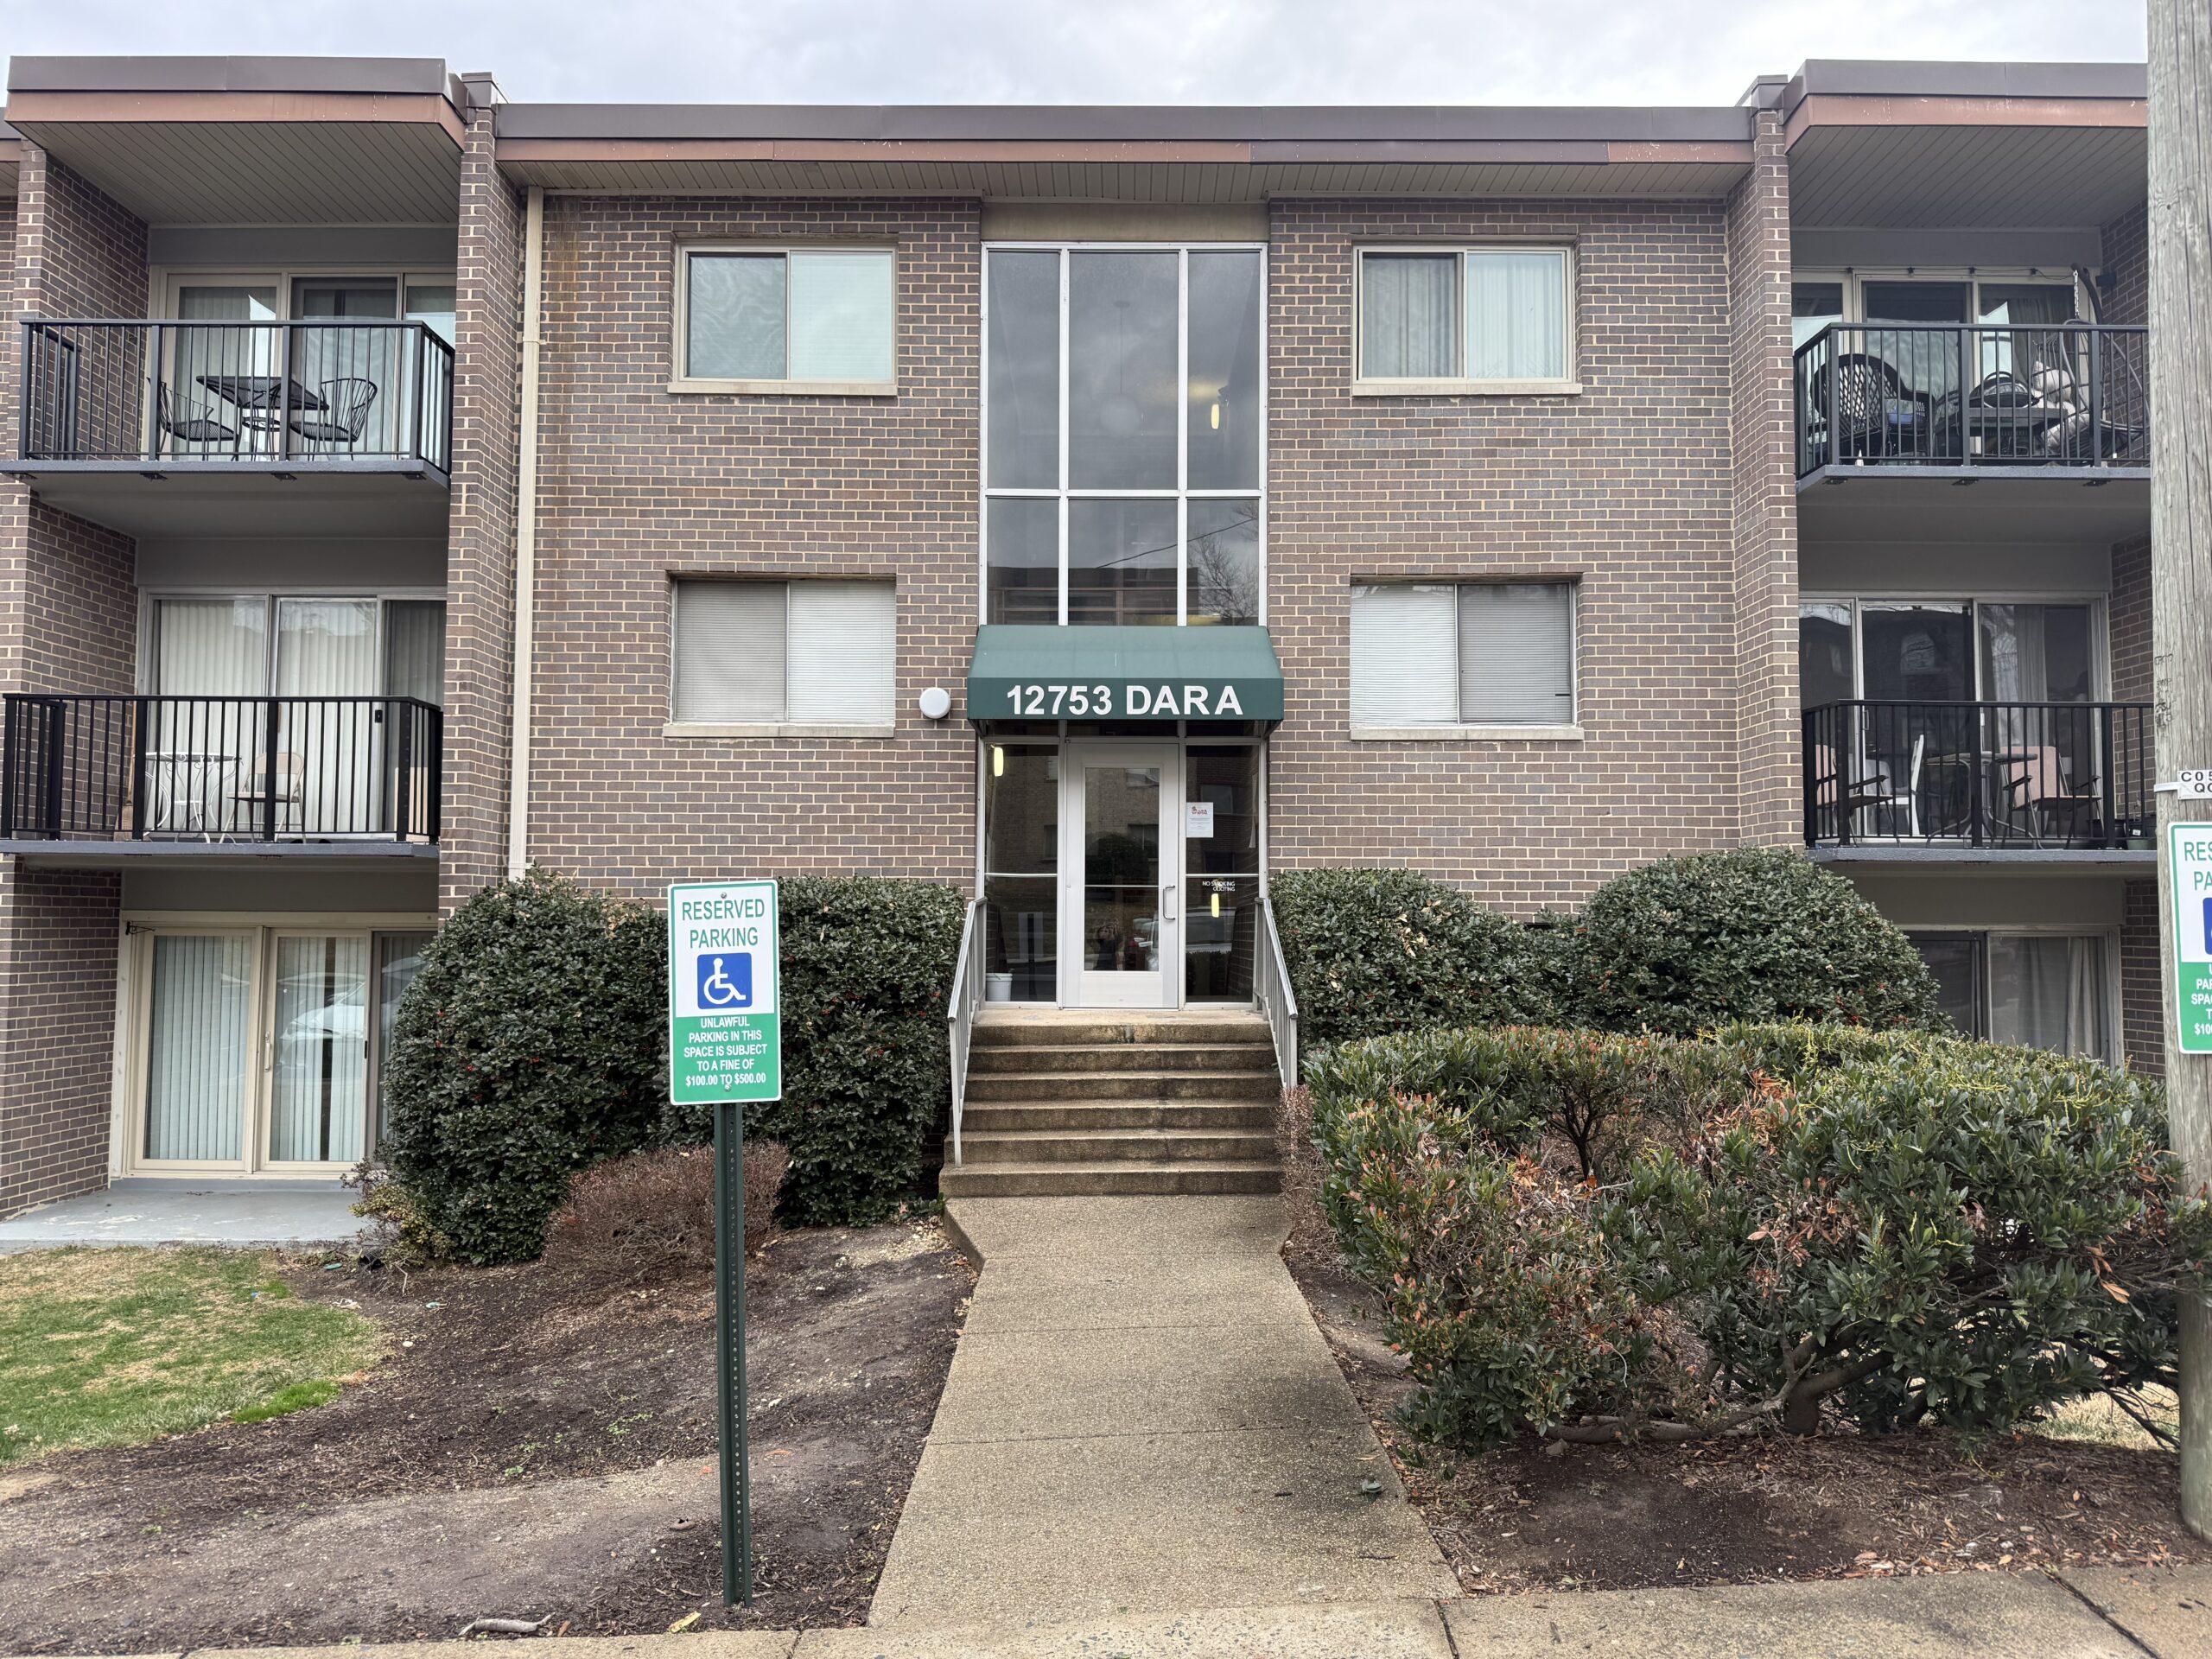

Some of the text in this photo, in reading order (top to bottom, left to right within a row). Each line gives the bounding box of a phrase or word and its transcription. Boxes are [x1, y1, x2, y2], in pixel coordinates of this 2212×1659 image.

[1007, 685, 1243, 715] 12753 DARA
[682, 898, 765, 921] RESERVED
[690, 927, 758, 949] PARKING
[2190, 993, 2212, 1005] SPA
[701, 1016, 750, 1028] UNLAWFUL
[2194, 1022, 2212, 1036] $10
[689, 1030, 762, 1043] PARKING IN THIS
[683, 1044, 767, 1058] SPACE IS SUBJECT
[696, 1058, 754, 1071] TO A FINE OF
[685, 1072, 766, 1087] $100.00 TO $500.00
